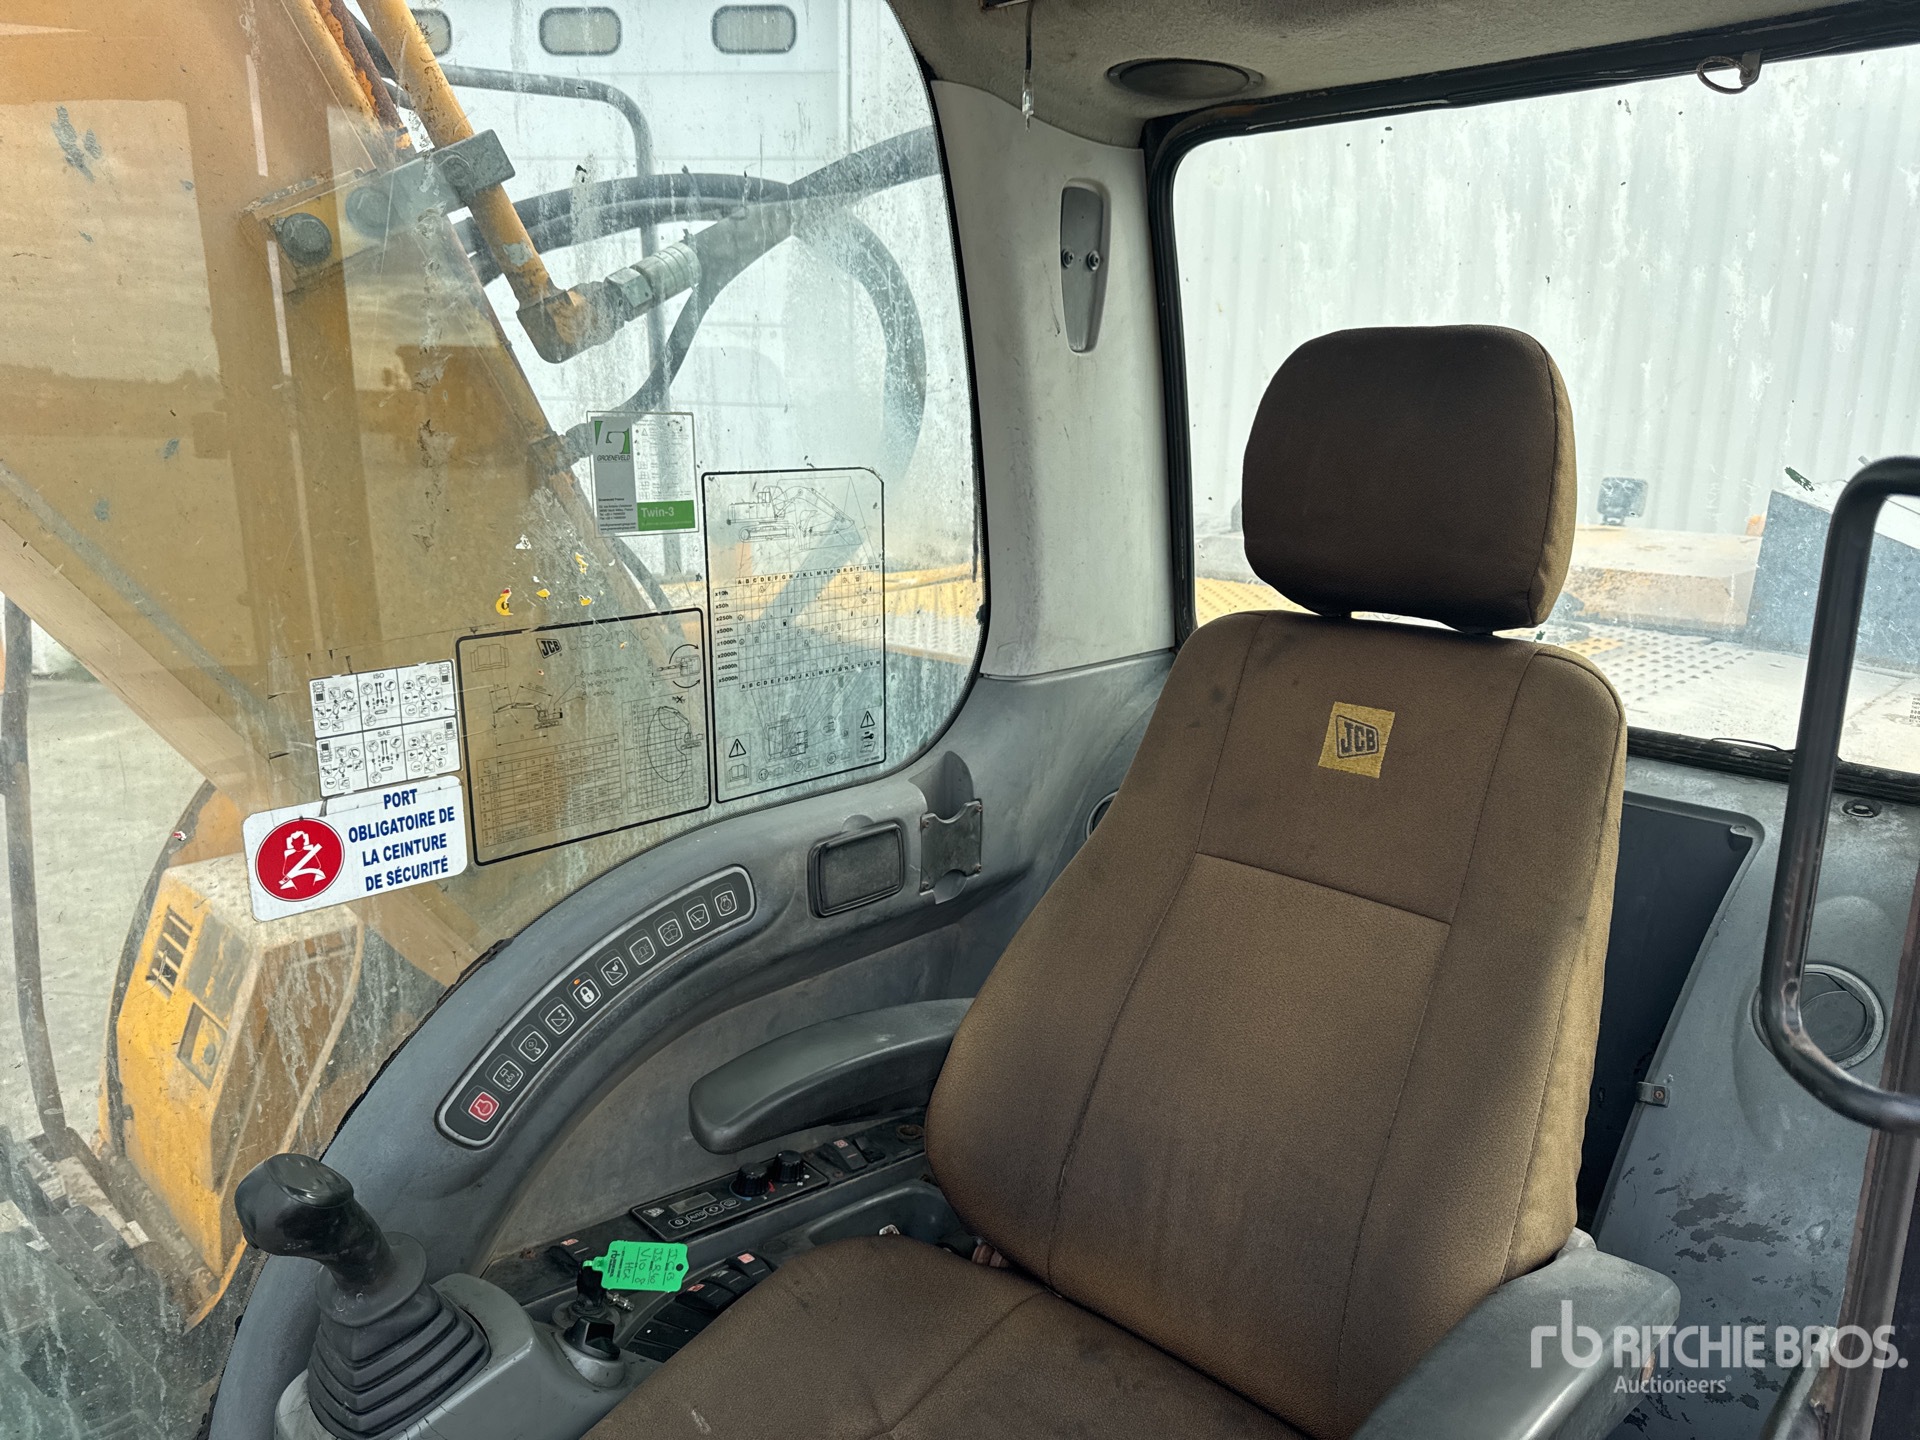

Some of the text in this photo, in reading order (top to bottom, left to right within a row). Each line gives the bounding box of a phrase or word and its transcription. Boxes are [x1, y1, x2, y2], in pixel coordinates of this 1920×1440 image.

[641, 507, 674, 518] Twin-3
[541, 640, 560, 656] JCB
[718, 663, 738, 671] x4000h
[1341, 721, 1375, 754] JCB
[383, 788, 417, 809] PORT
[348, 806, 455, 843] OBLIGATOIRE DE
[362, 833, 447, 866] LA CEINTURE
[365, 857, 449, 891] DE SÉCURITÉ
[667, 1249, 678, 1281] JCB
